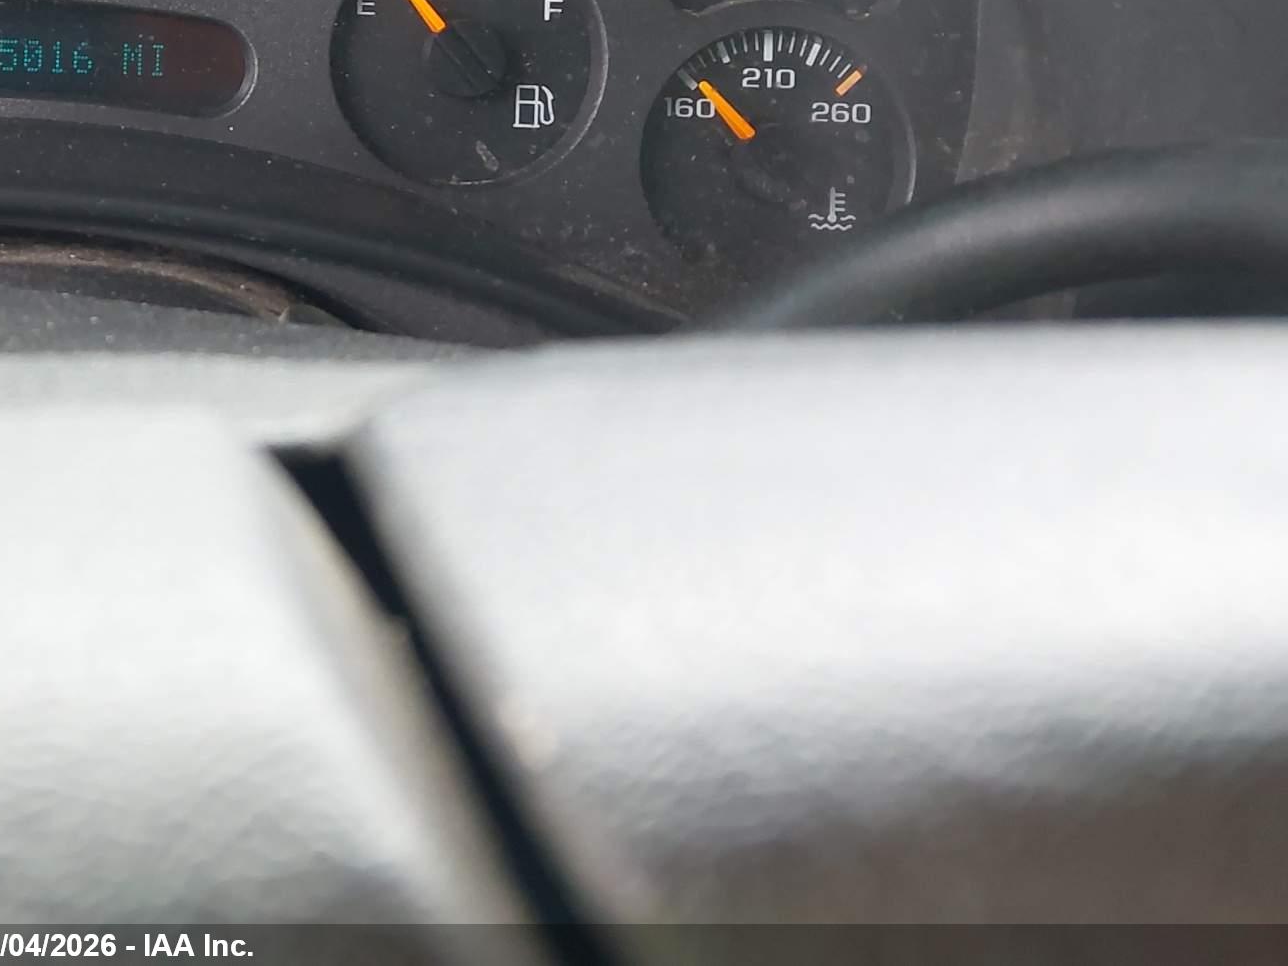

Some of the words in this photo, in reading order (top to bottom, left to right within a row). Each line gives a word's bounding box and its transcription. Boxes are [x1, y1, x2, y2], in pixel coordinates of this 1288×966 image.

[544, 0, 564, 21] F
[121, 42, 165, 78] MI
[741, 69, 795, 89] 210
[664, 97, 716, 118] 160
[811, 103, 870, 123] 260
